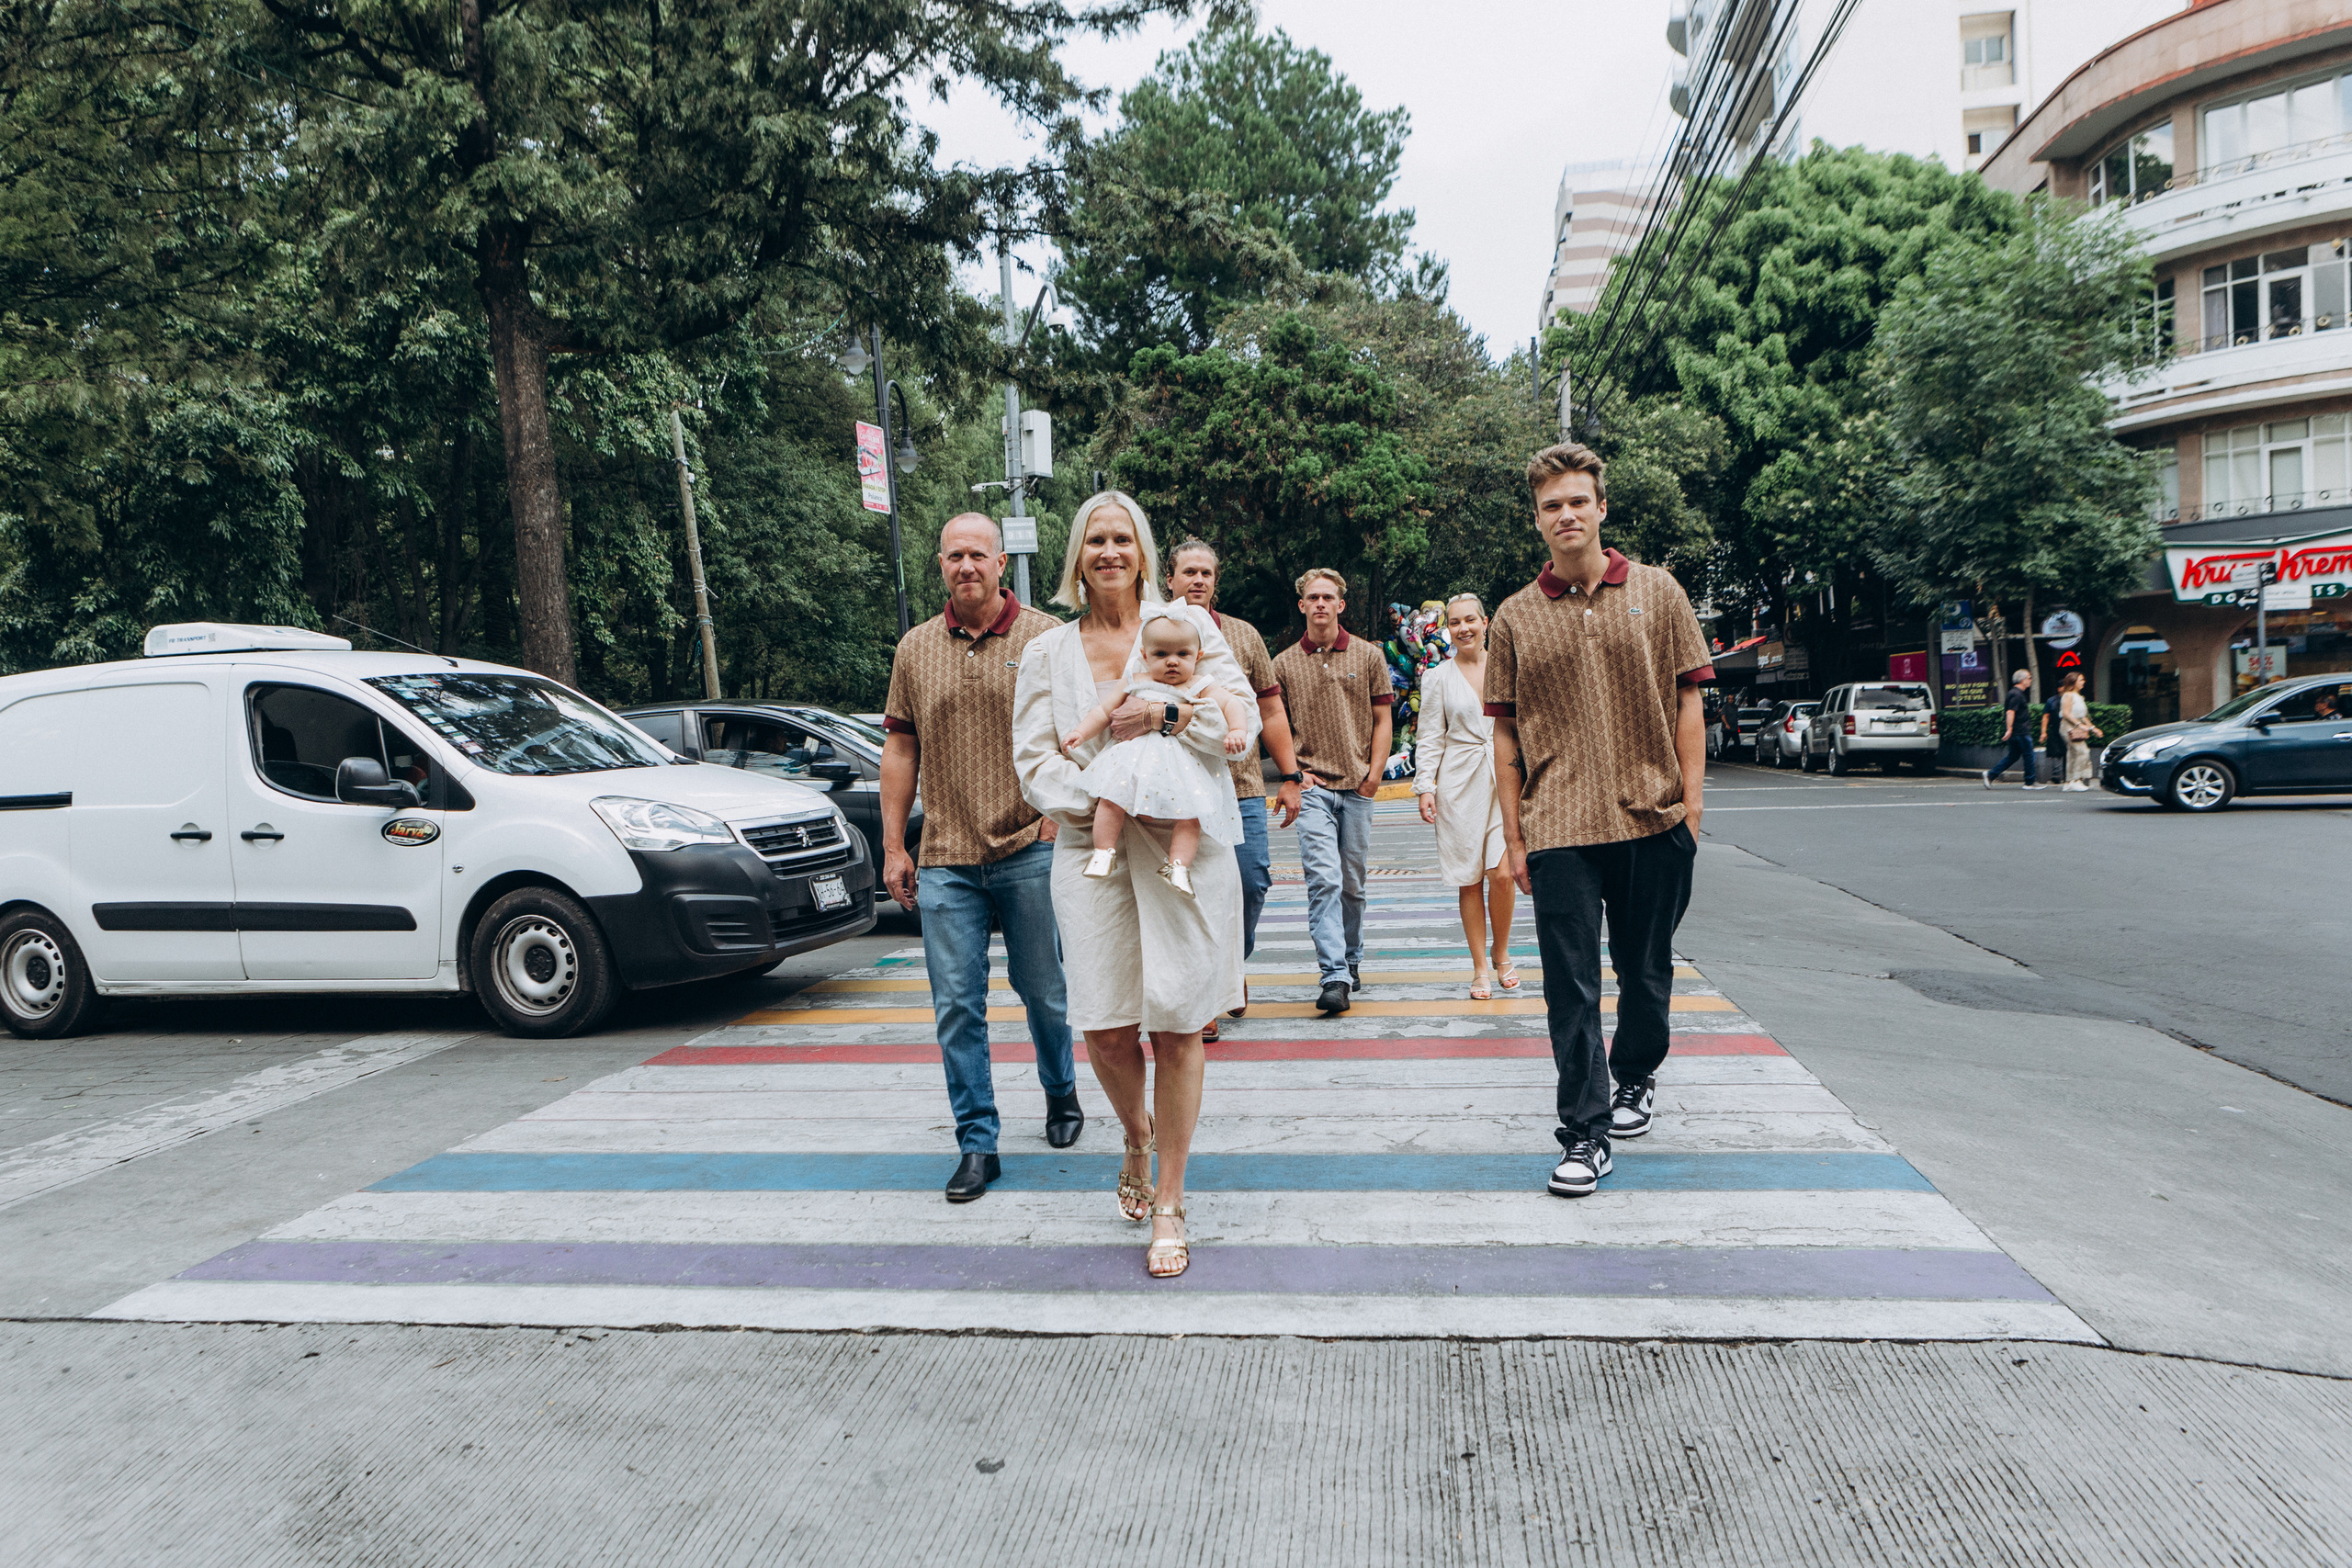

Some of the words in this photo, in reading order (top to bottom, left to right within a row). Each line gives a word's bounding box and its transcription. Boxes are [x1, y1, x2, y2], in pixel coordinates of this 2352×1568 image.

[868, 492, 883, 502] Polanco
[2276, 545, 2352, 582] Krem
[176, 635, 207, 643] TRANSPORT
